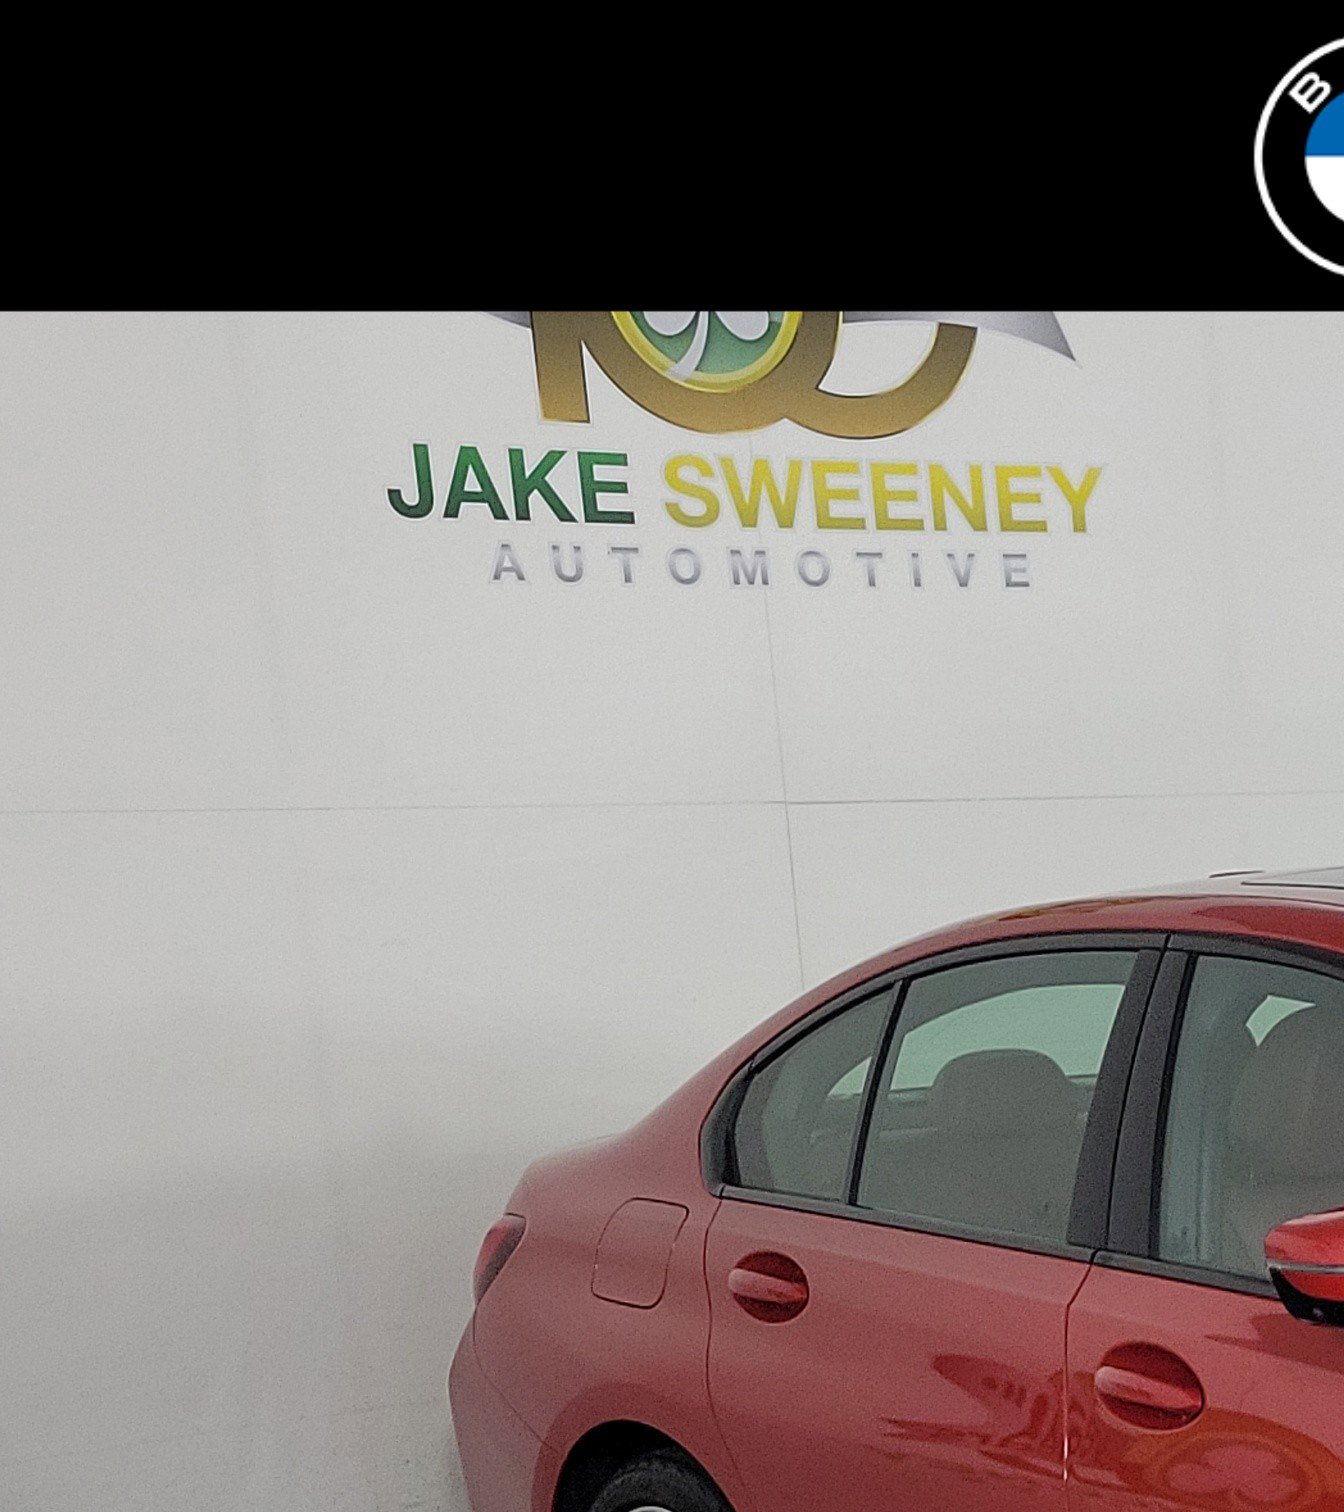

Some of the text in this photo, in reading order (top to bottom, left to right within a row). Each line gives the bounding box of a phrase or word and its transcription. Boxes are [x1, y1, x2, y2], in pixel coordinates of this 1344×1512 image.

[386, 443, 1103, 534] JAKE SWEENEY
[491, 543, 1032, 588] AUTOMOTIVE
